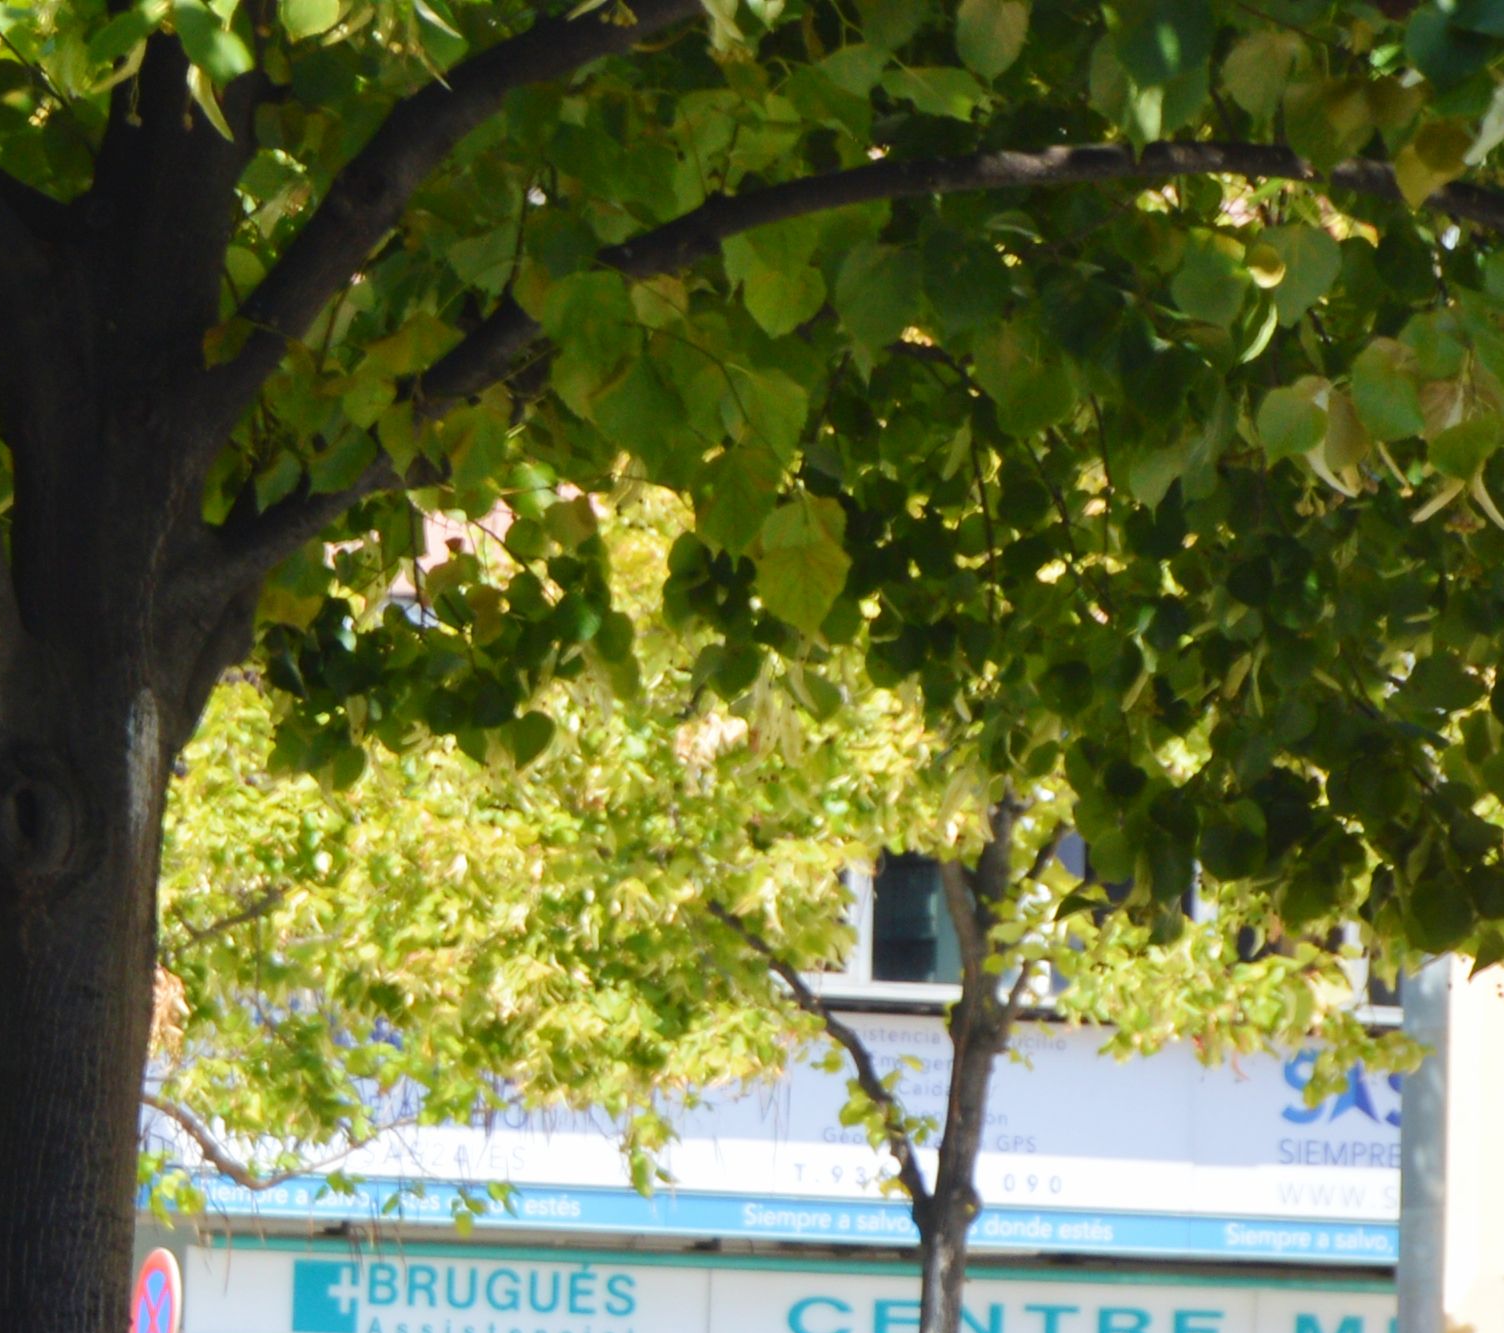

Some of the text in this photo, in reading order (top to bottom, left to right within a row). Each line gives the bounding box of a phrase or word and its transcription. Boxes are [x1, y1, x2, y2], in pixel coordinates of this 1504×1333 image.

[995, 1134, 1038, 1153] GPS
[1279, 1138, 1402, 1169] SIEMPRE
[524, 1193, 582, 1218] estés
[744, 1202, 832, 1233] Siempre
[839, 1212, 851, 1229] a
[856, 1209, 917, 1236] salvo,
[984, 1208, 1053, 1238] donde
[1058, 1213, 1114, 1241] estés
[1225, 1222, 1395, 1254] Siempre a salvo,
[367, 1261, 638, 1317] BRUGUÉS
